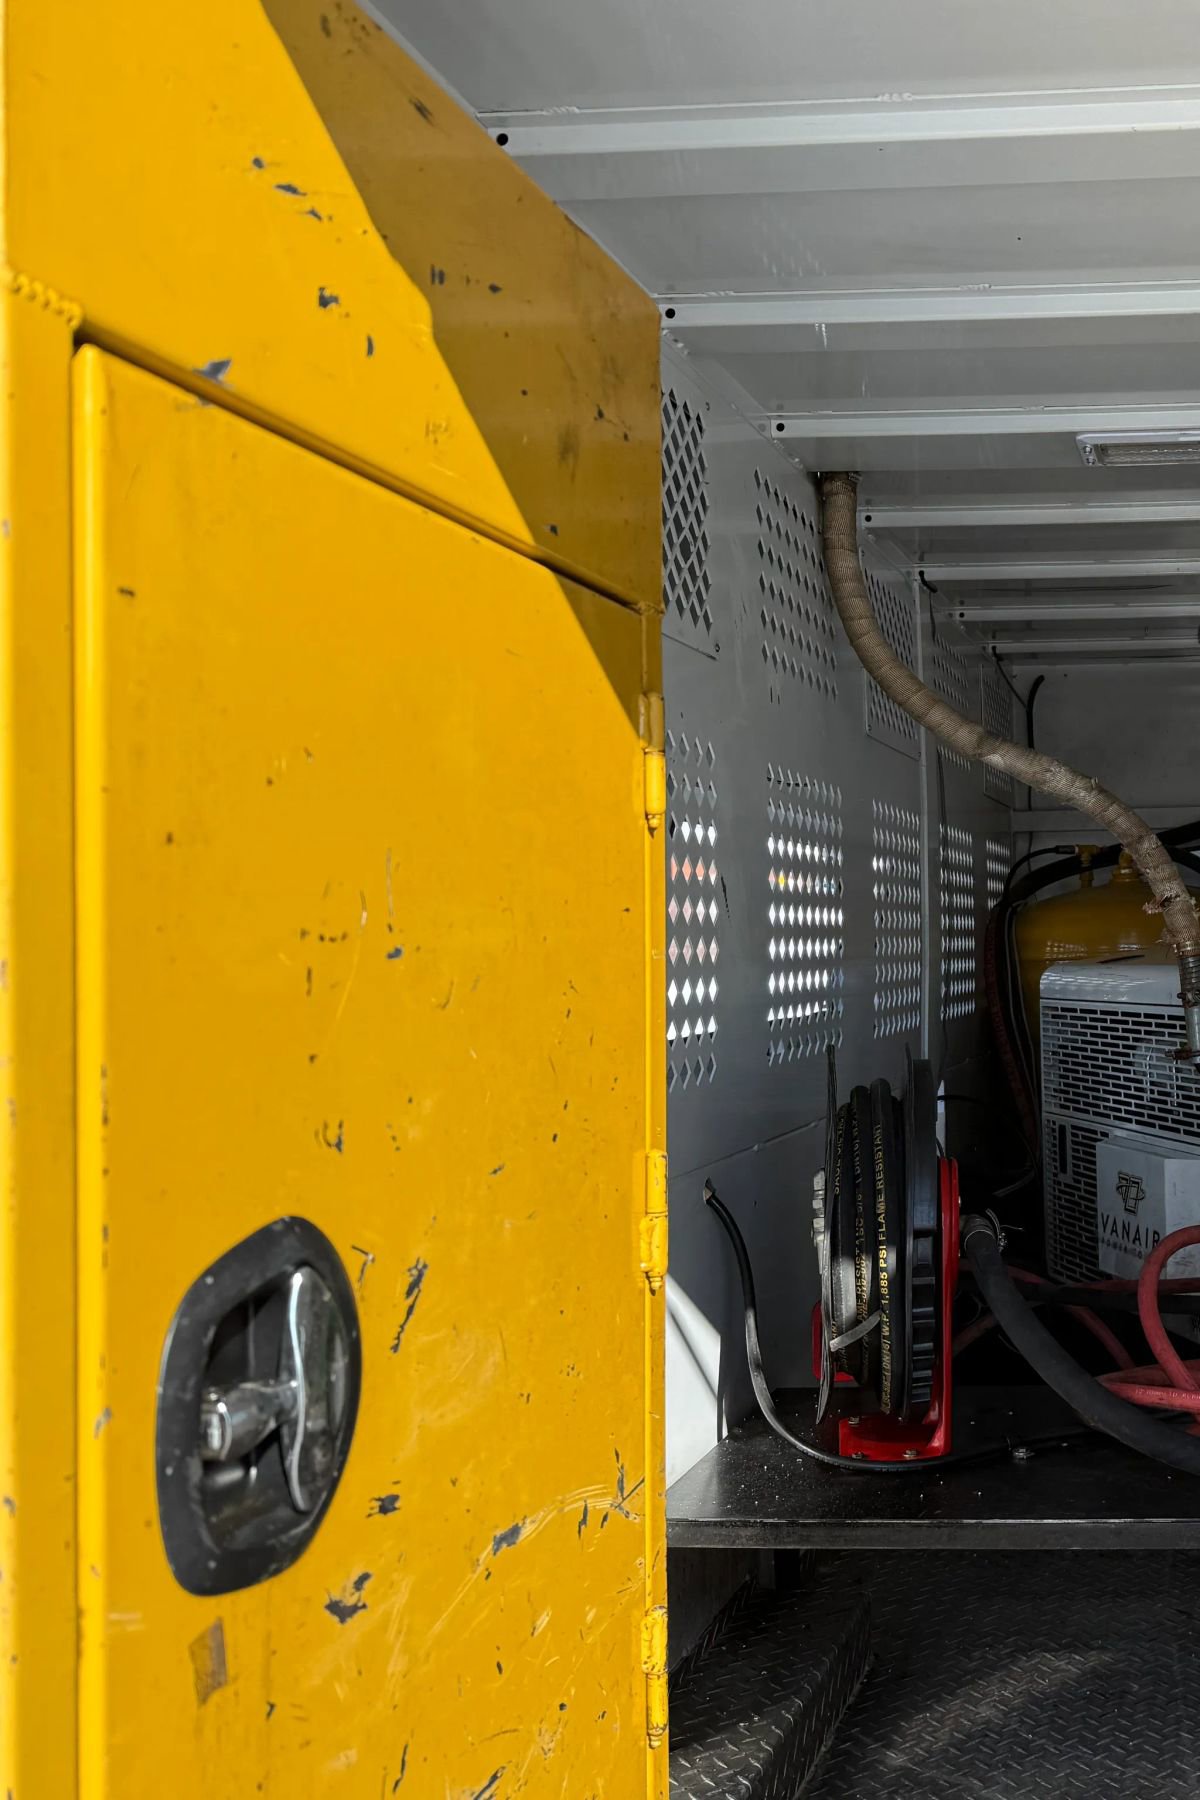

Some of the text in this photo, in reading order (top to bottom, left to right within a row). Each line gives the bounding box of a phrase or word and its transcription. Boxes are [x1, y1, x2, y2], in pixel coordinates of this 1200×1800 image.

[873, 1124, 884, 1189] RESISTANT
[877, 1192, 886, 1240] FLAME
[1101, 1212, 1161, 1250] VANAIR
[878, 1245, 887, 1268] PSI
[879, 1271, 889, 1305] 1,885
